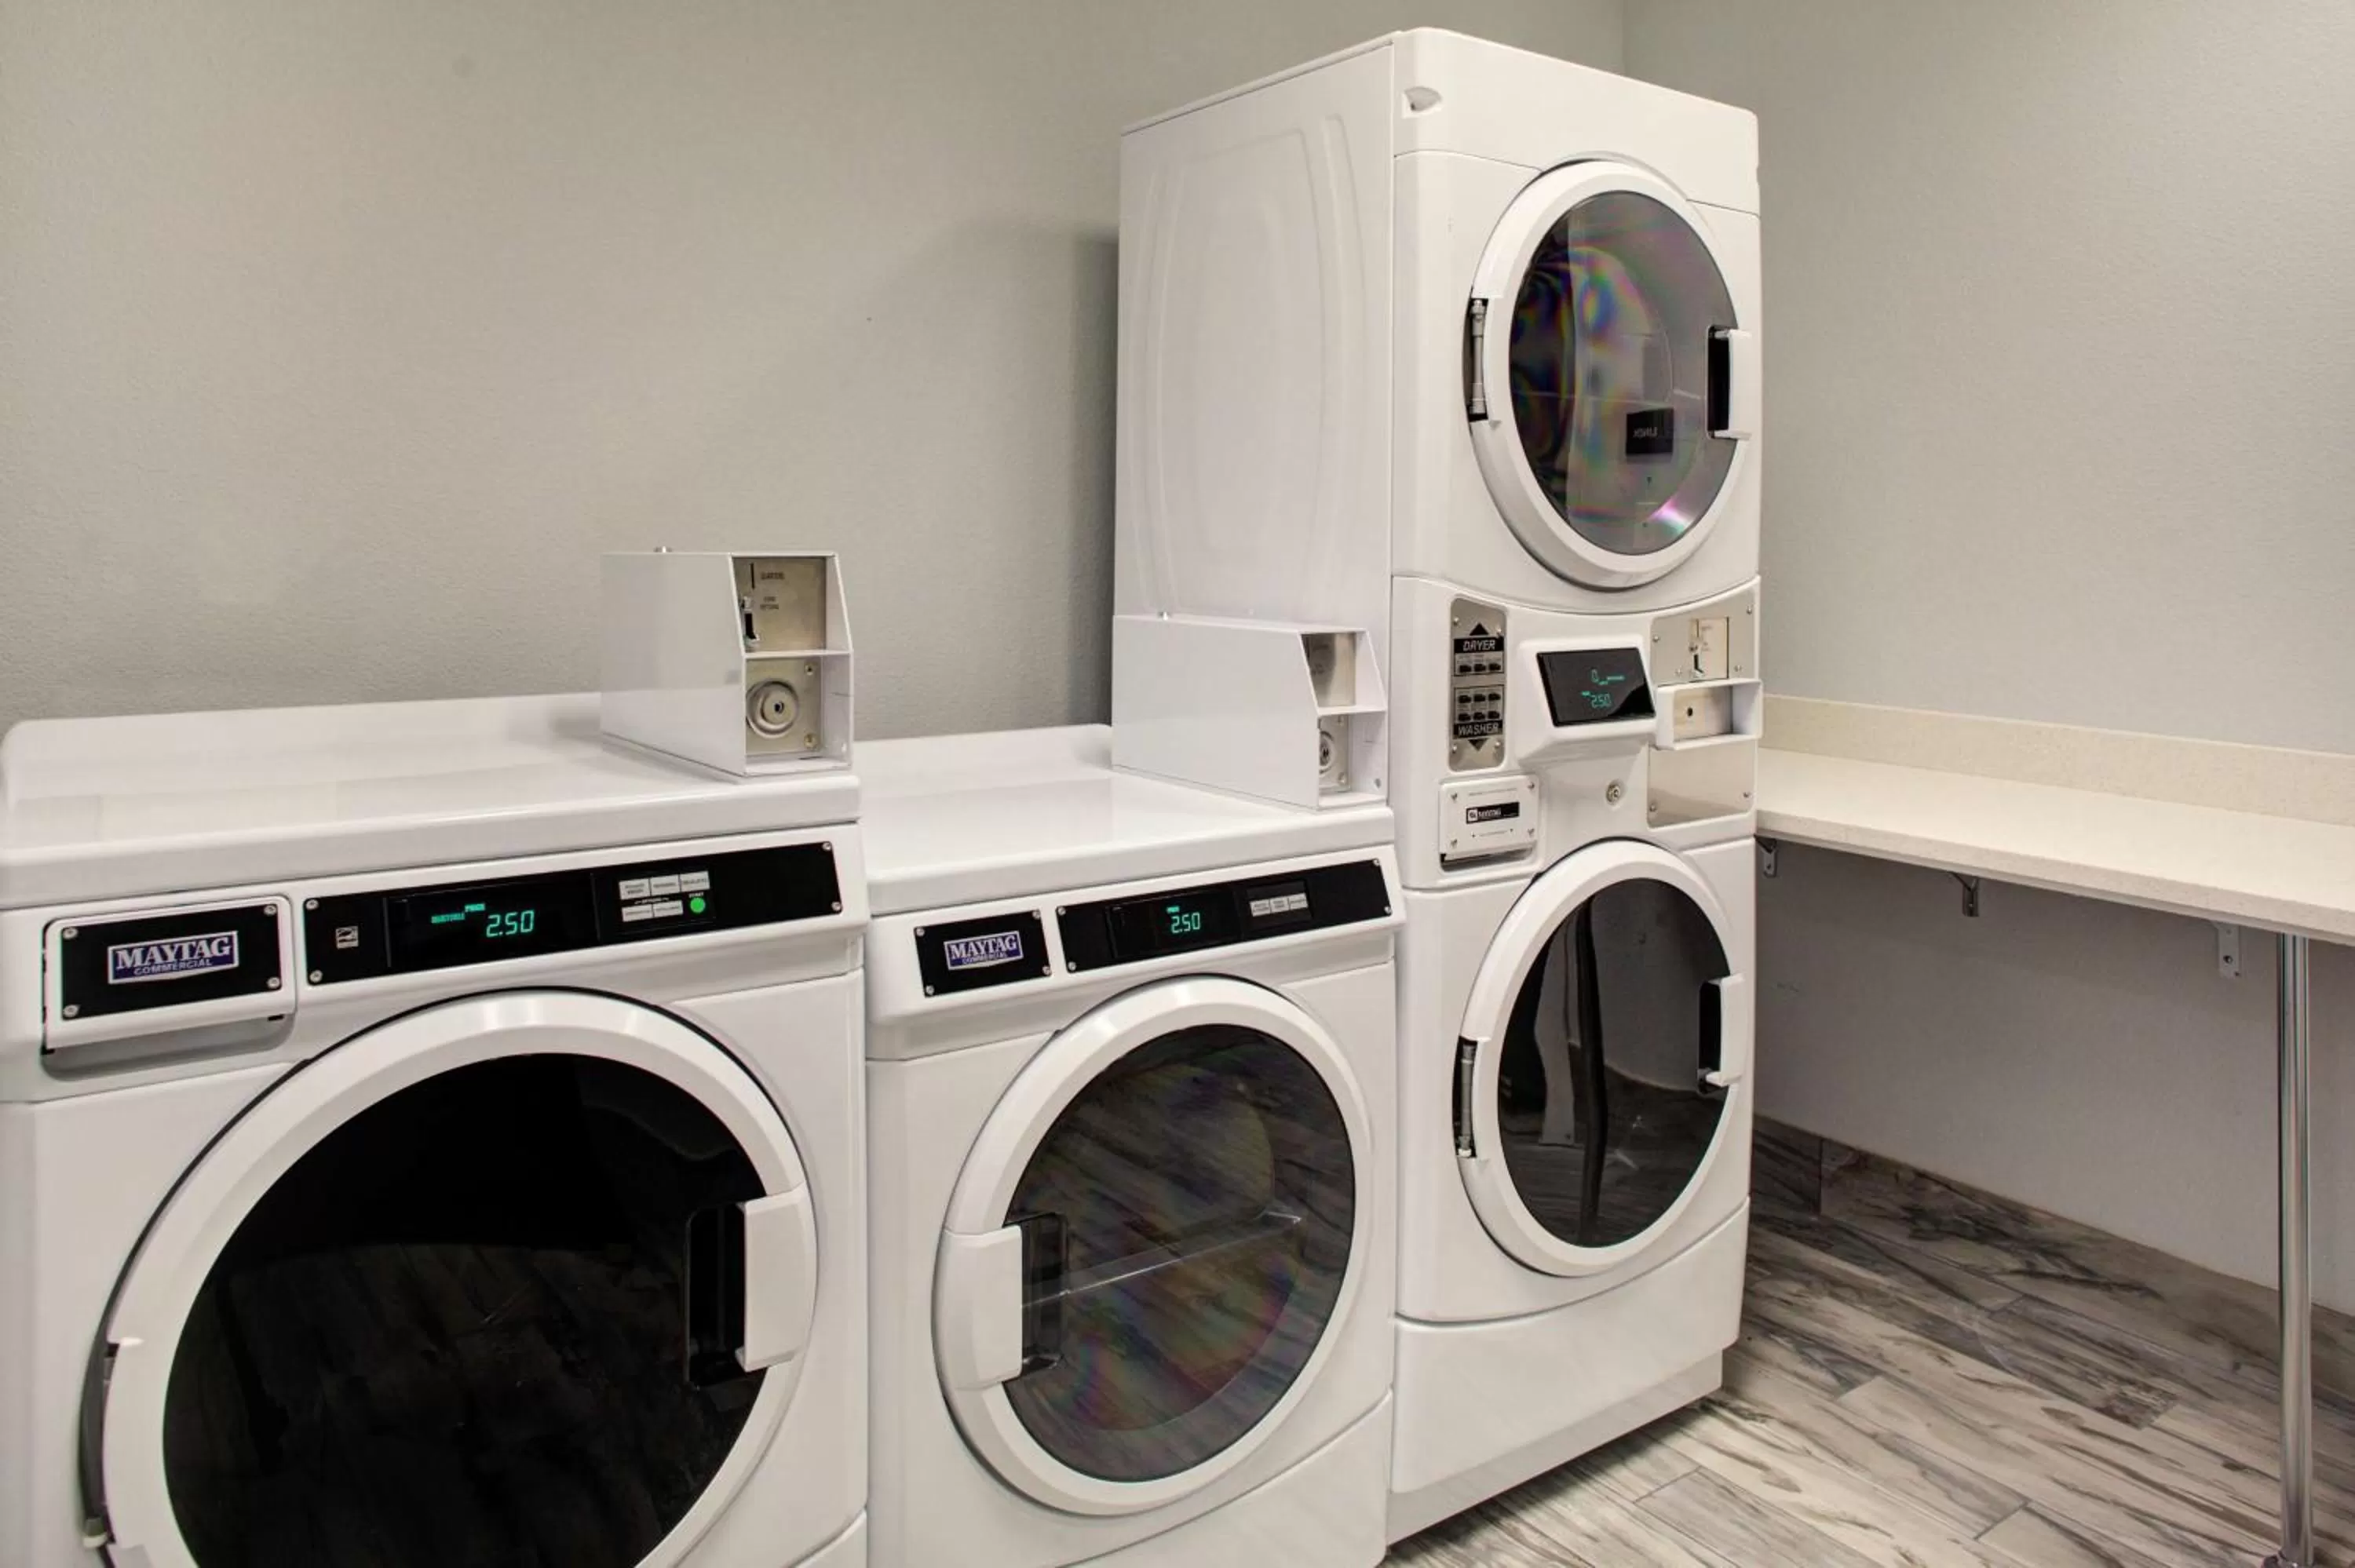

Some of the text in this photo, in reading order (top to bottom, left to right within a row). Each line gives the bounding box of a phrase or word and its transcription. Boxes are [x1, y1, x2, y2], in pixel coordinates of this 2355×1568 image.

[1462, 640, 1495, 651] DRYER
[1459, 722, 1499, 735] WASHER
[486, 910, 535, 938] 2.50
[1171, 912, 1201, 934] 2.50
[115, 936, 232, 970] MAYTAG
[949, 935, 1017, 960] MAYTAG
[133, 958, 213, 975] COMMERCIAL
